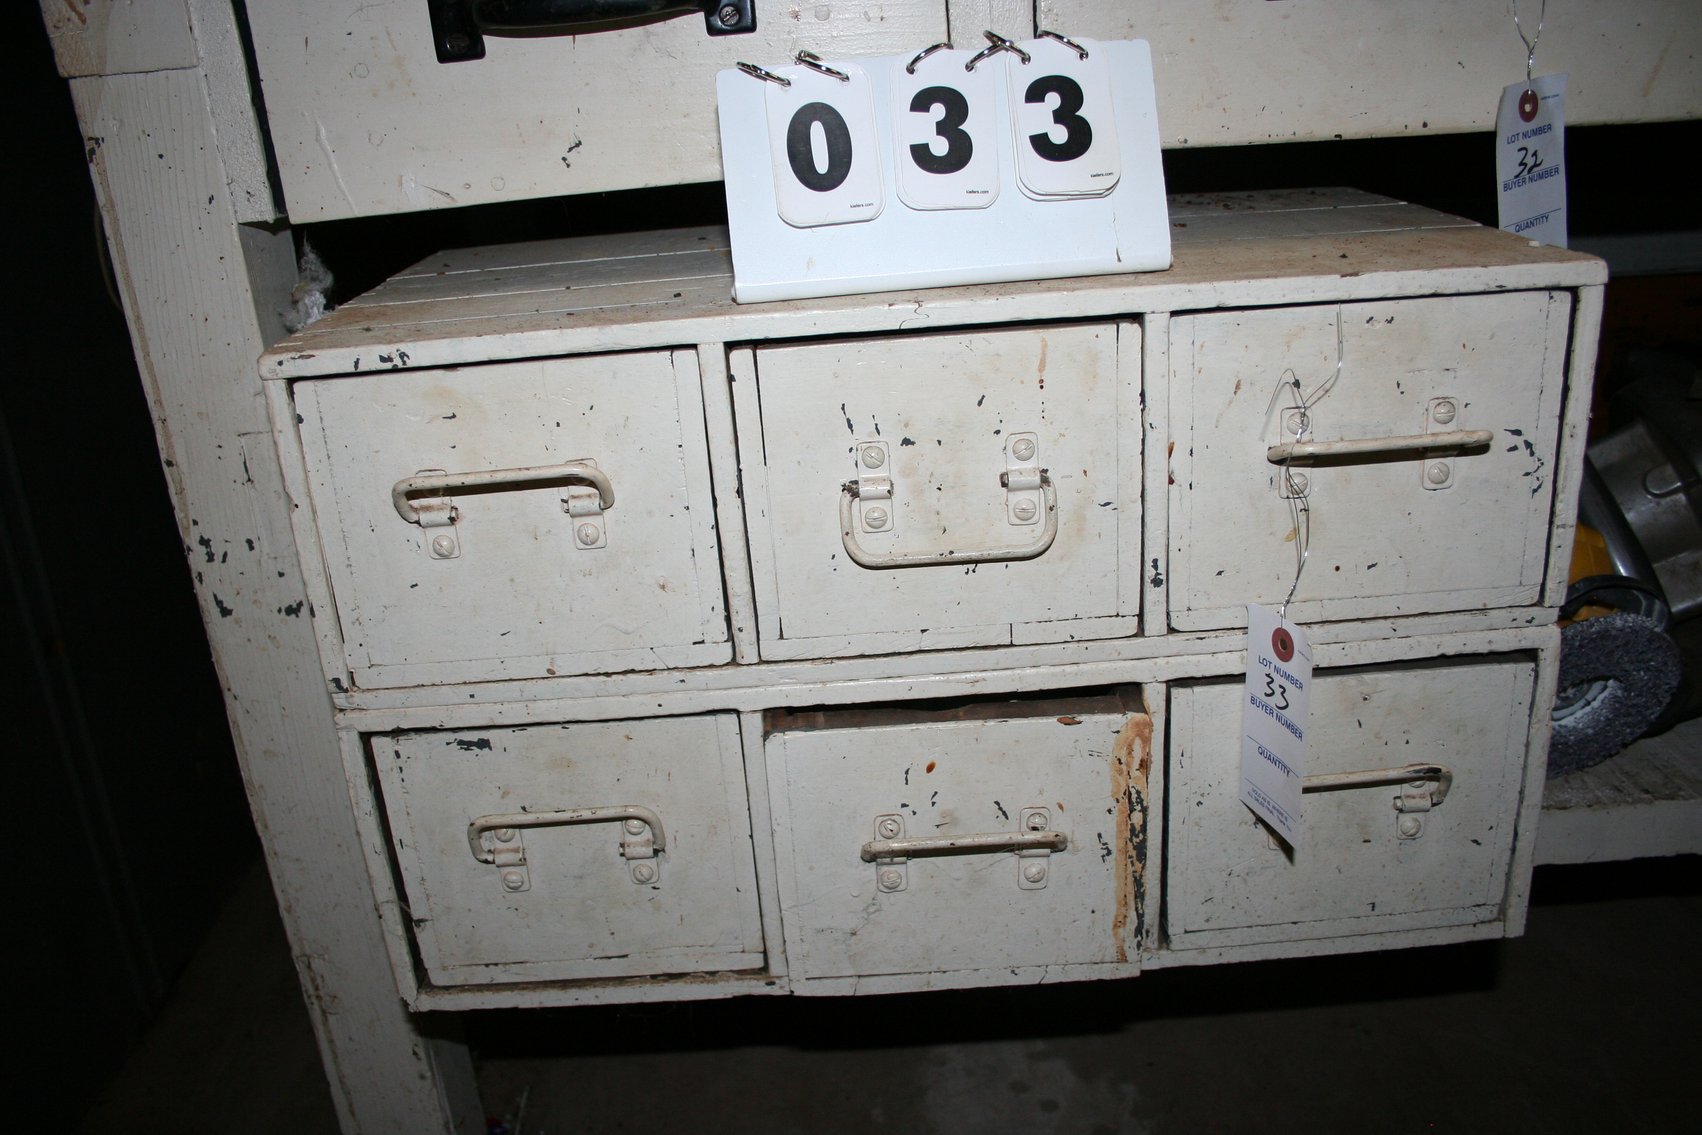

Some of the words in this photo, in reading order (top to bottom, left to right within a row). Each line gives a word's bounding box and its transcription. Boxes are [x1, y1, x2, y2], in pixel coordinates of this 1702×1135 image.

[787, 102, 852, 192] 0
[909, 86, 973, 175] 3
[1025, 75, 1092, 162] 3
[1506, 133, 1521, 145] LOT
[1522, 123, 1552, 140] NUMBER
[1514, 147, 1544, 179] 32
[1503, 176, 1527, 193] BUYER
[1528, 166, 1560, 184] NUMBER
[1514, 214, 1550, 233] QUANTITY
[1258, 655, 1272, 670] LOT
[1274, 664, 1304, 692] NUMBER
[1264, 673, 1290, 711] 33
[1250, 696, 1275, 718] BUYER
[1275, 713, 1304, 742] NUMBER
[1257, 746, 1291, 777] QUANTITY
